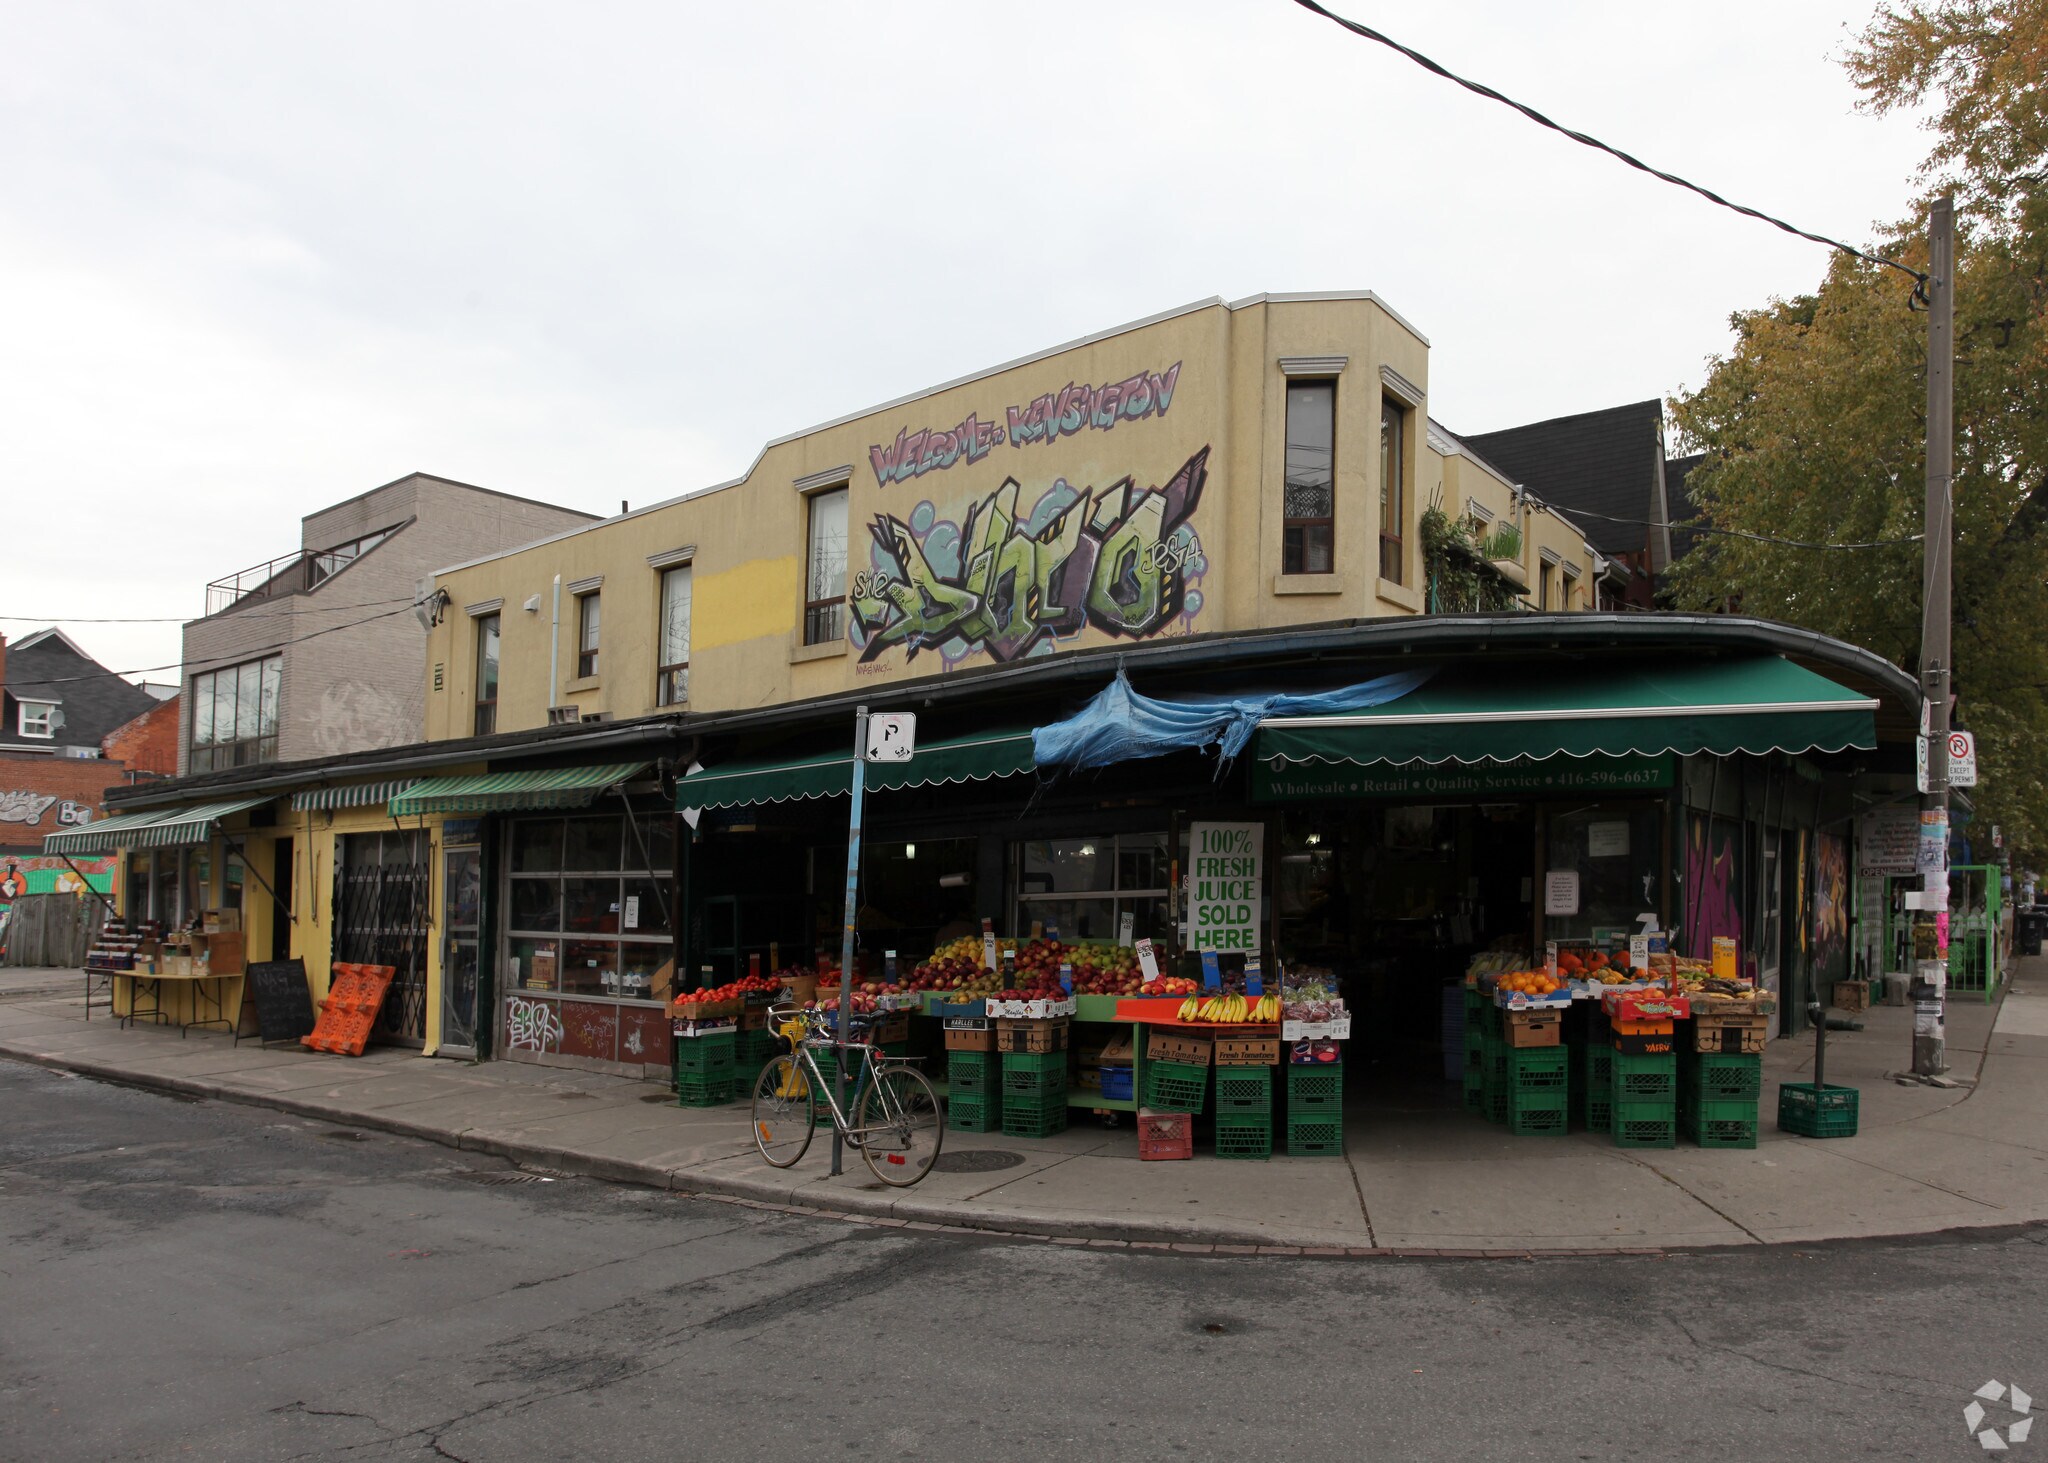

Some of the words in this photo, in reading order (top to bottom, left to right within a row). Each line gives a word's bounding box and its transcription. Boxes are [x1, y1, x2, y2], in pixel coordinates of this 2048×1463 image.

[869, 411, 995, 489] WELCOME
[1270, 781, 1346, 795] Wholesale
[1363, 779, 1408, 792] Retail
[1425, 776, 1480, 792] Quality
[1485, 774, 1540, 788] Service
[1557, 769, 1659, 785] 416-596-6637
[1200, 829, 1253, 854] 100%
[1196, 857, 1255, 877] FRESH
[1862, 867, 1887, 877] OPEN
[1194, 880, 1256, 902] JUICE
[1198, 904, 1251, 926] SOLD
[1194, 928, 1254, 949] HERE
[1150, 1047, 1170, 1057] Fresh
[1171, 1050, 1207, 1061] Tomatoes
[1219, 1051, 1239, 1059] Fresh
[1240, 1051, 1275, 1059] Tomatoes
